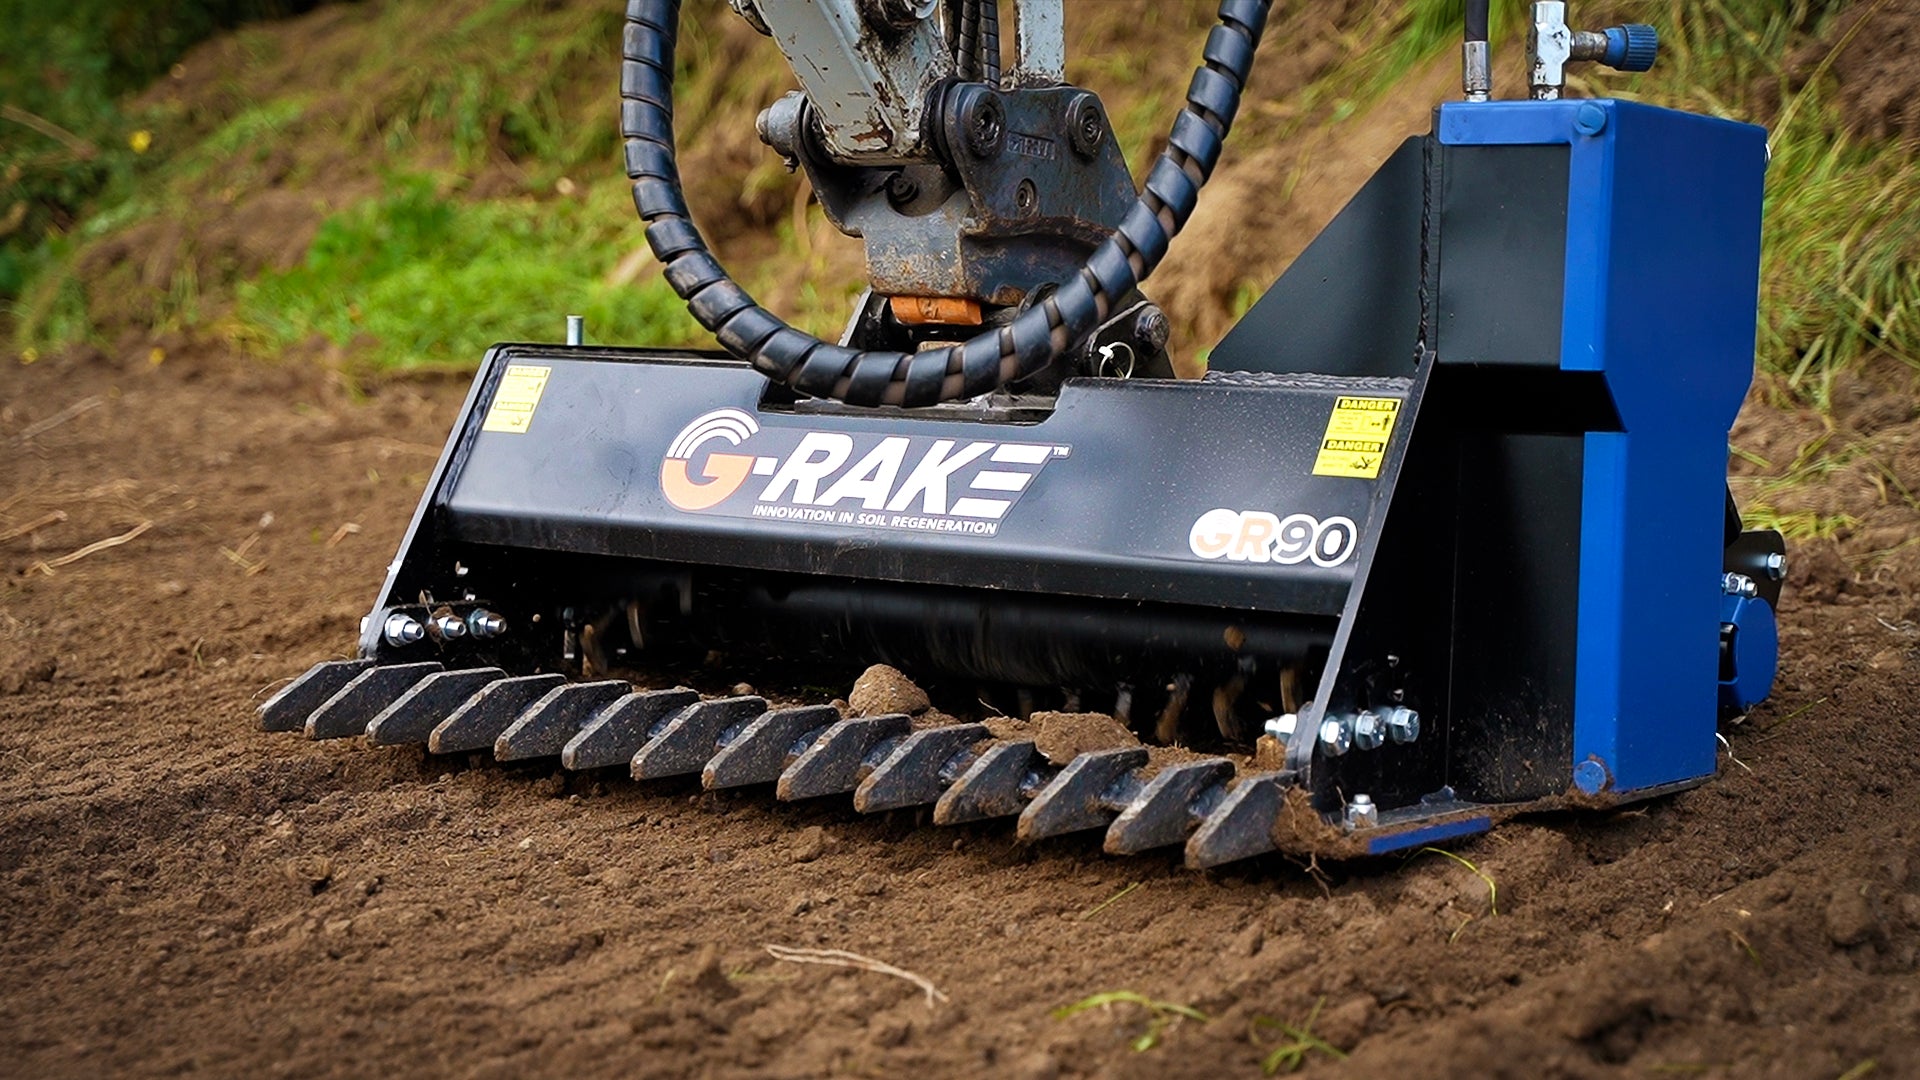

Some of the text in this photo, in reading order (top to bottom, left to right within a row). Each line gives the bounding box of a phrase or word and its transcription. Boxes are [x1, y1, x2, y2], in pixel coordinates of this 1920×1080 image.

[1340, 400, 1394, 411] DANGER
[1326, 440, 1380, 452] DANGER
[662, 409, 1052, 518] G-RAKE
[752, 505, 997, 534] INNOVATION IN SOIL REGENERATION
[1189, 508, 1357, 567] GR90
